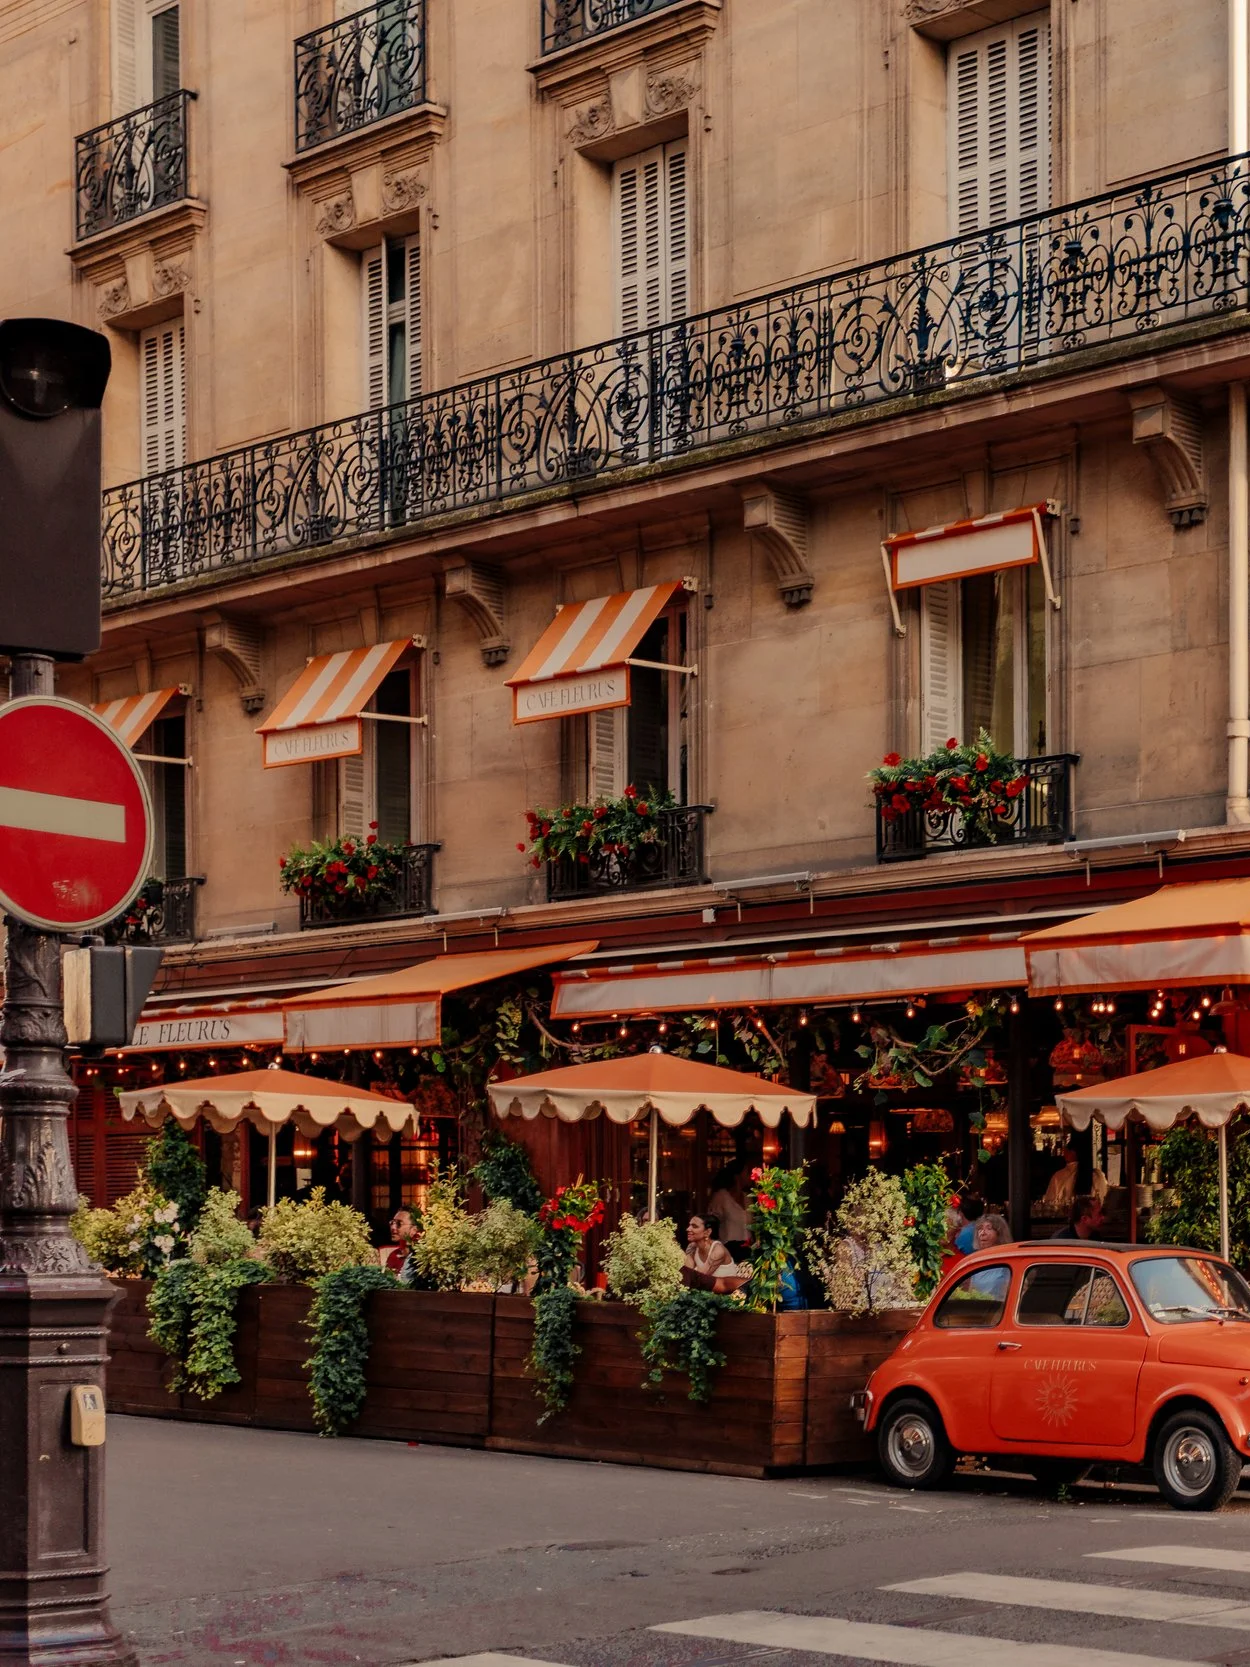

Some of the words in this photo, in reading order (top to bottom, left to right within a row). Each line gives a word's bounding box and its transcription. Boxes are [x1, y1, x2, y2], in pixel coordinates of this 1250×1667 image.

[560, 679, 616, 706] FLEURUS
[303, 730, 350, 754] FLEURUS
[158, 1018, 232, 1044] FLEURUS
[1050, 1359, 1097, 1371] FLEURUS
